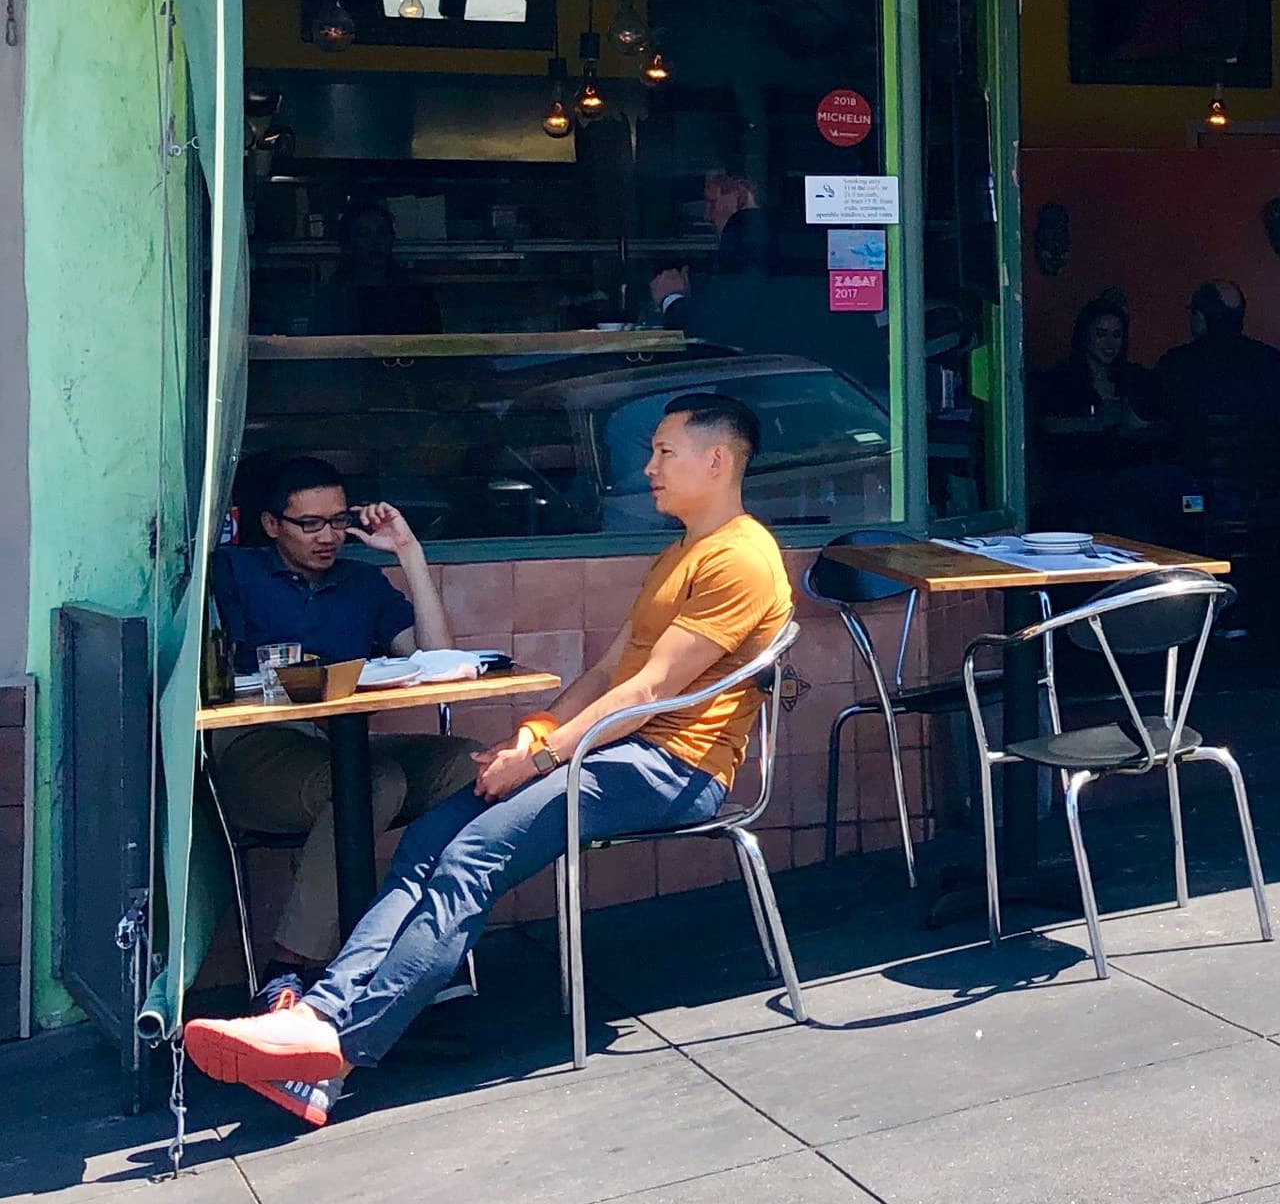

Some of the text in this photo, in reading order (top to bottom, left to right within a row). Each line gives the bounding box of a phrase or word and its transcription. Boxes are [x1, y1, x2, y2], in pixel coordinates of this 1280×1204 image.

[833, 96, 857, 106] 2018
[817, 111, 871, 125] MICHELIN
[835, 288, 858, 299] 2017
